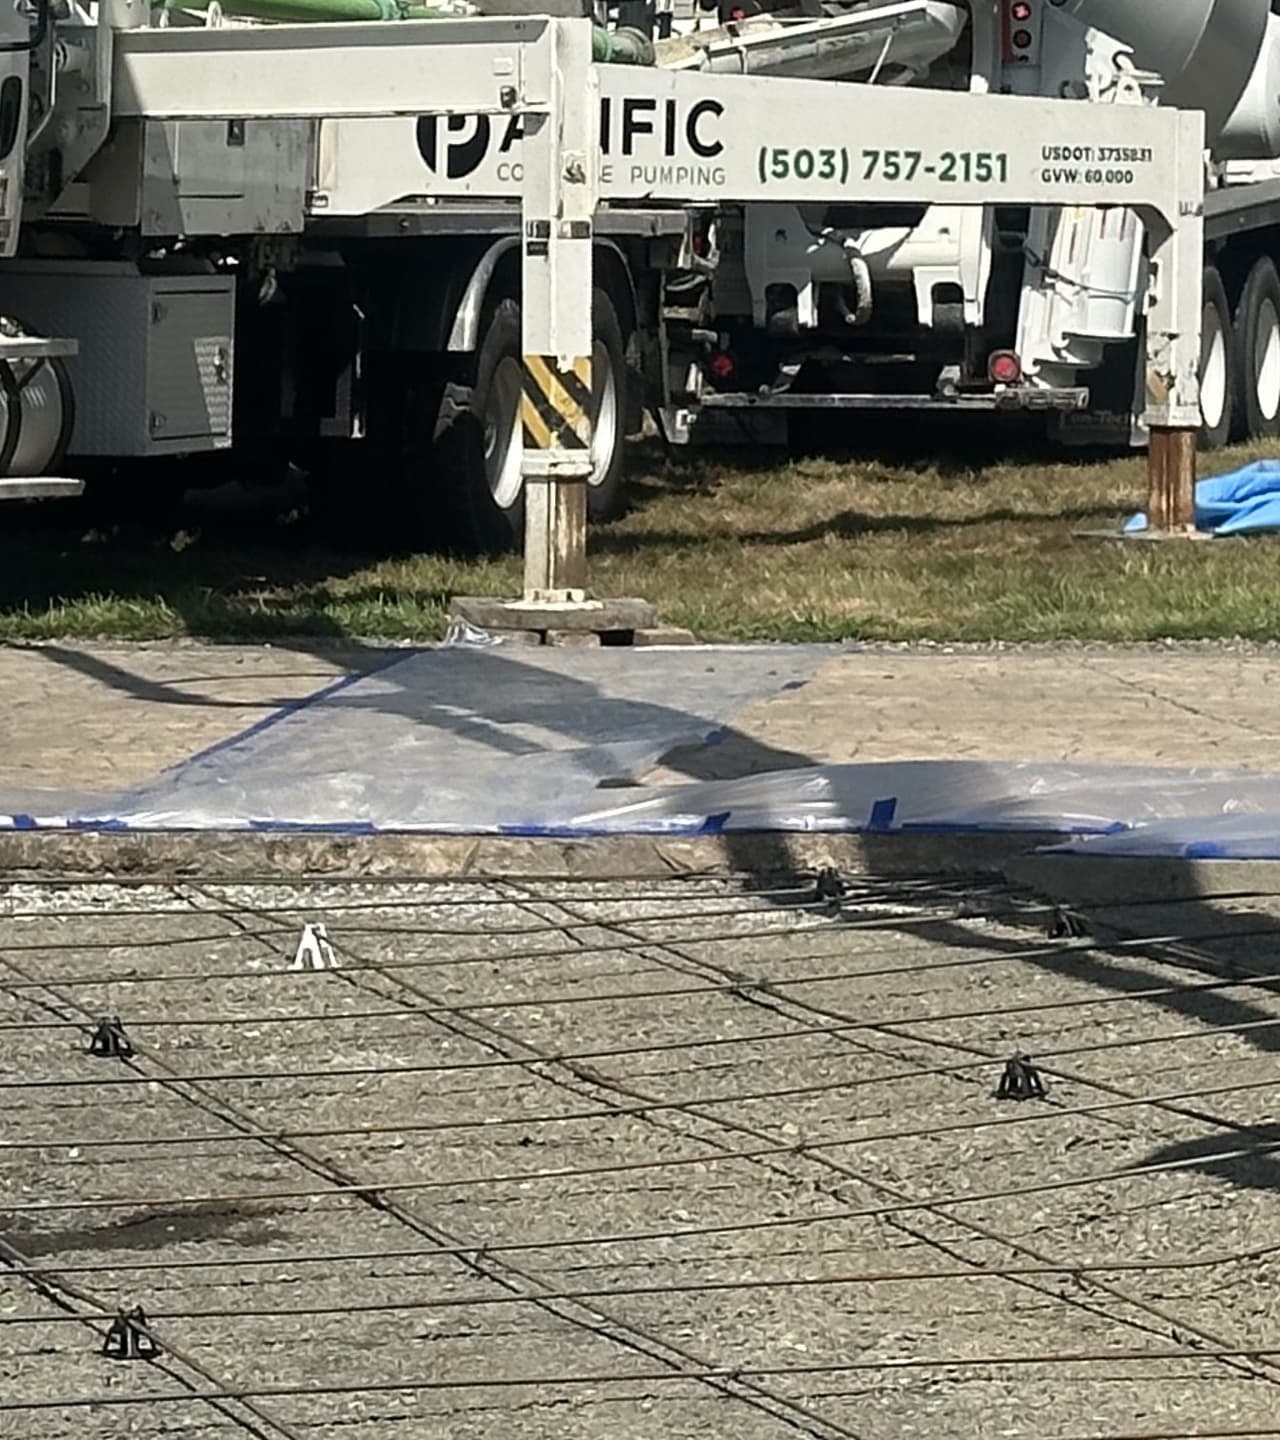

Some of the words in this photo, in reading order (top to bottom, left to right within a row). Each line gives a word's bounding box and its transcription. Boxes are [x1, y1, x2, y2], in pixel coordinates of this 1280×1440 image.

[416, 97, 725, 179] PIFIC
[631, 166, 725, 185] PUMPING
[758, 147, 849, 184] (503)
[861, 150, 1008, 182] 757-2151
